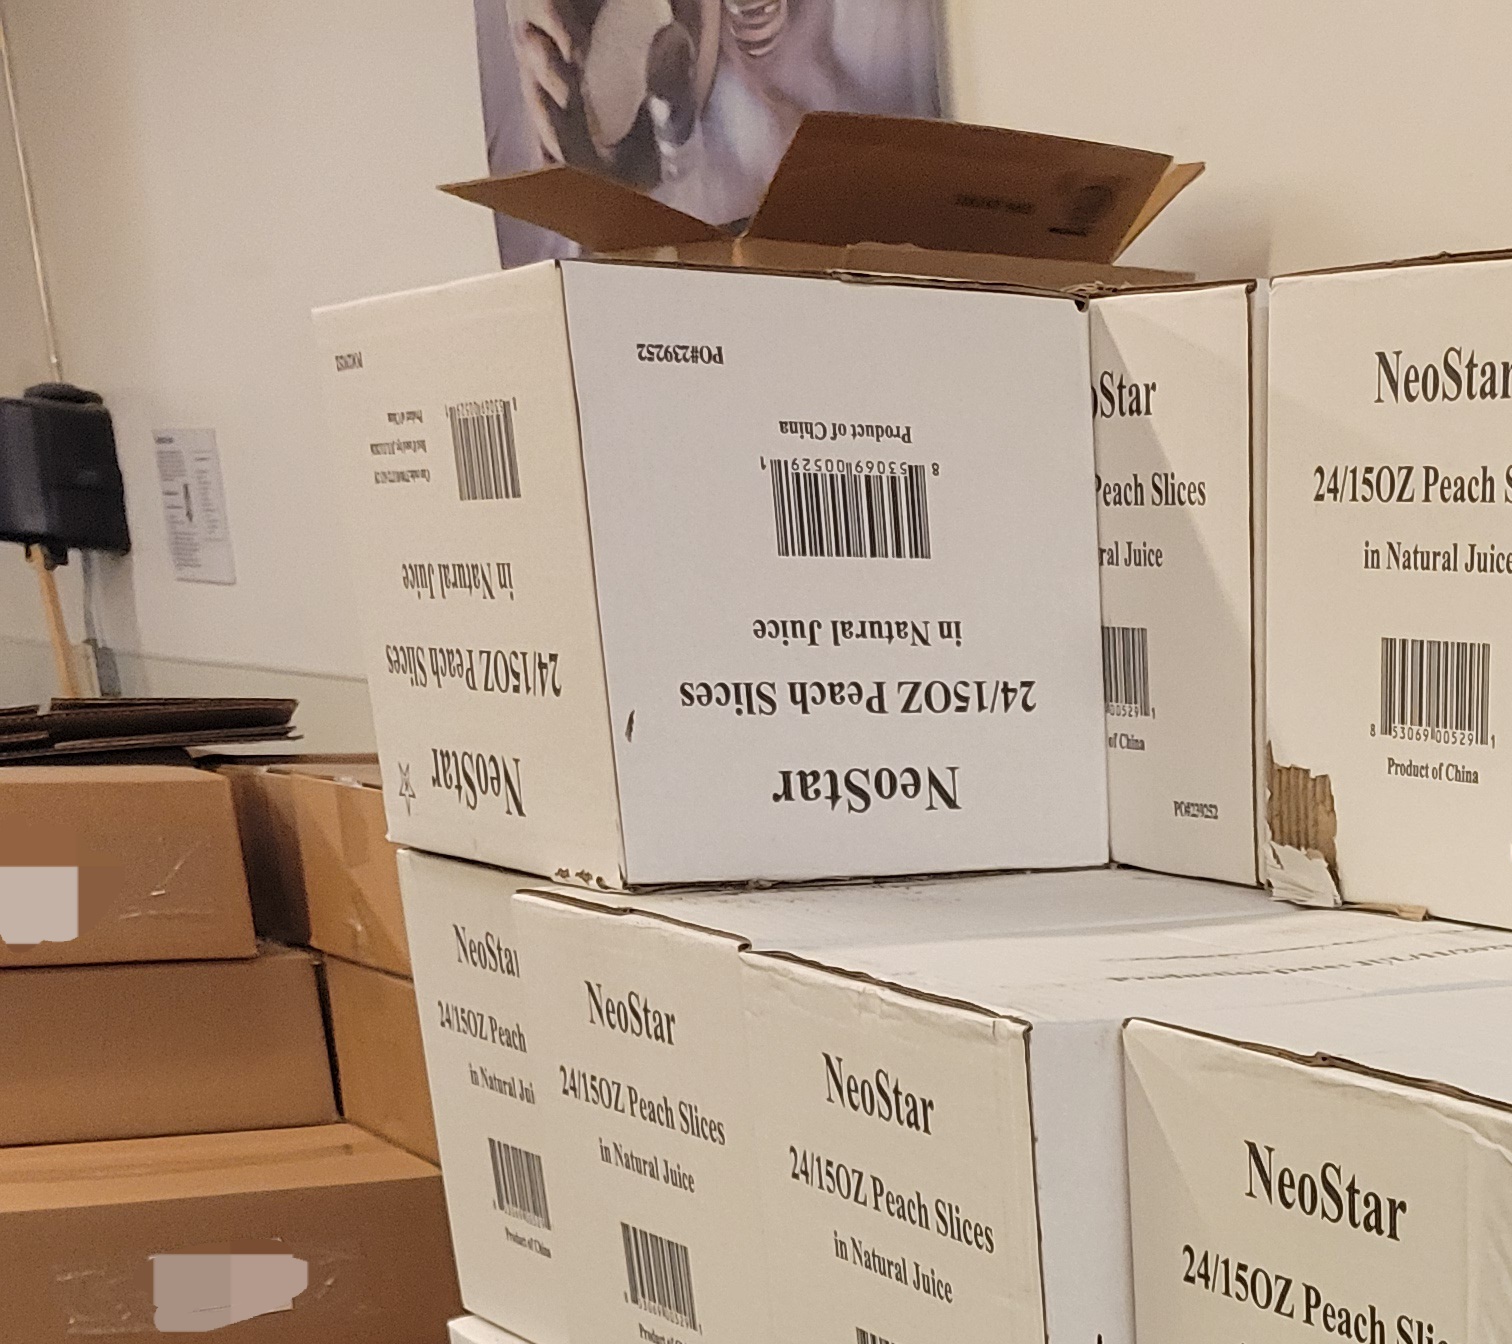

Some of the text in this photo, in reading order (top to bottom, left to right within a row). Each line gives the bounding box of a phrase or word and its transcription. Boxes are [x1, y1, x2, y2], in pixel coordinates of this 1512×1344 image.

[637, 344, 724, 364] PO#239252
[779, 421, 912, 443] Product of China
[1314, 466, 1414, 503] 24/15OZ
[1422, 466, 1495, 503] Peach
[1364, 540, 1380, 569] in
[1386, 541, 1458, 572] Natural
[753, 619, 961, 647] in Natural Juice
[680, 680, 1036, 716] 24/15OZ Peach Slices
[1387, 757, 1479, 784] Product of China
[772, 767, 961, 813] NeoStar
[822, 1052, 934, 1135] NeoStar
[790, 1146, 994, 1253] 24/15OZ Peach Slices
[1244, 1140, 1407, 1241] NeoStar
[1183, 1245, 1294, 1319] 24/15OZ
